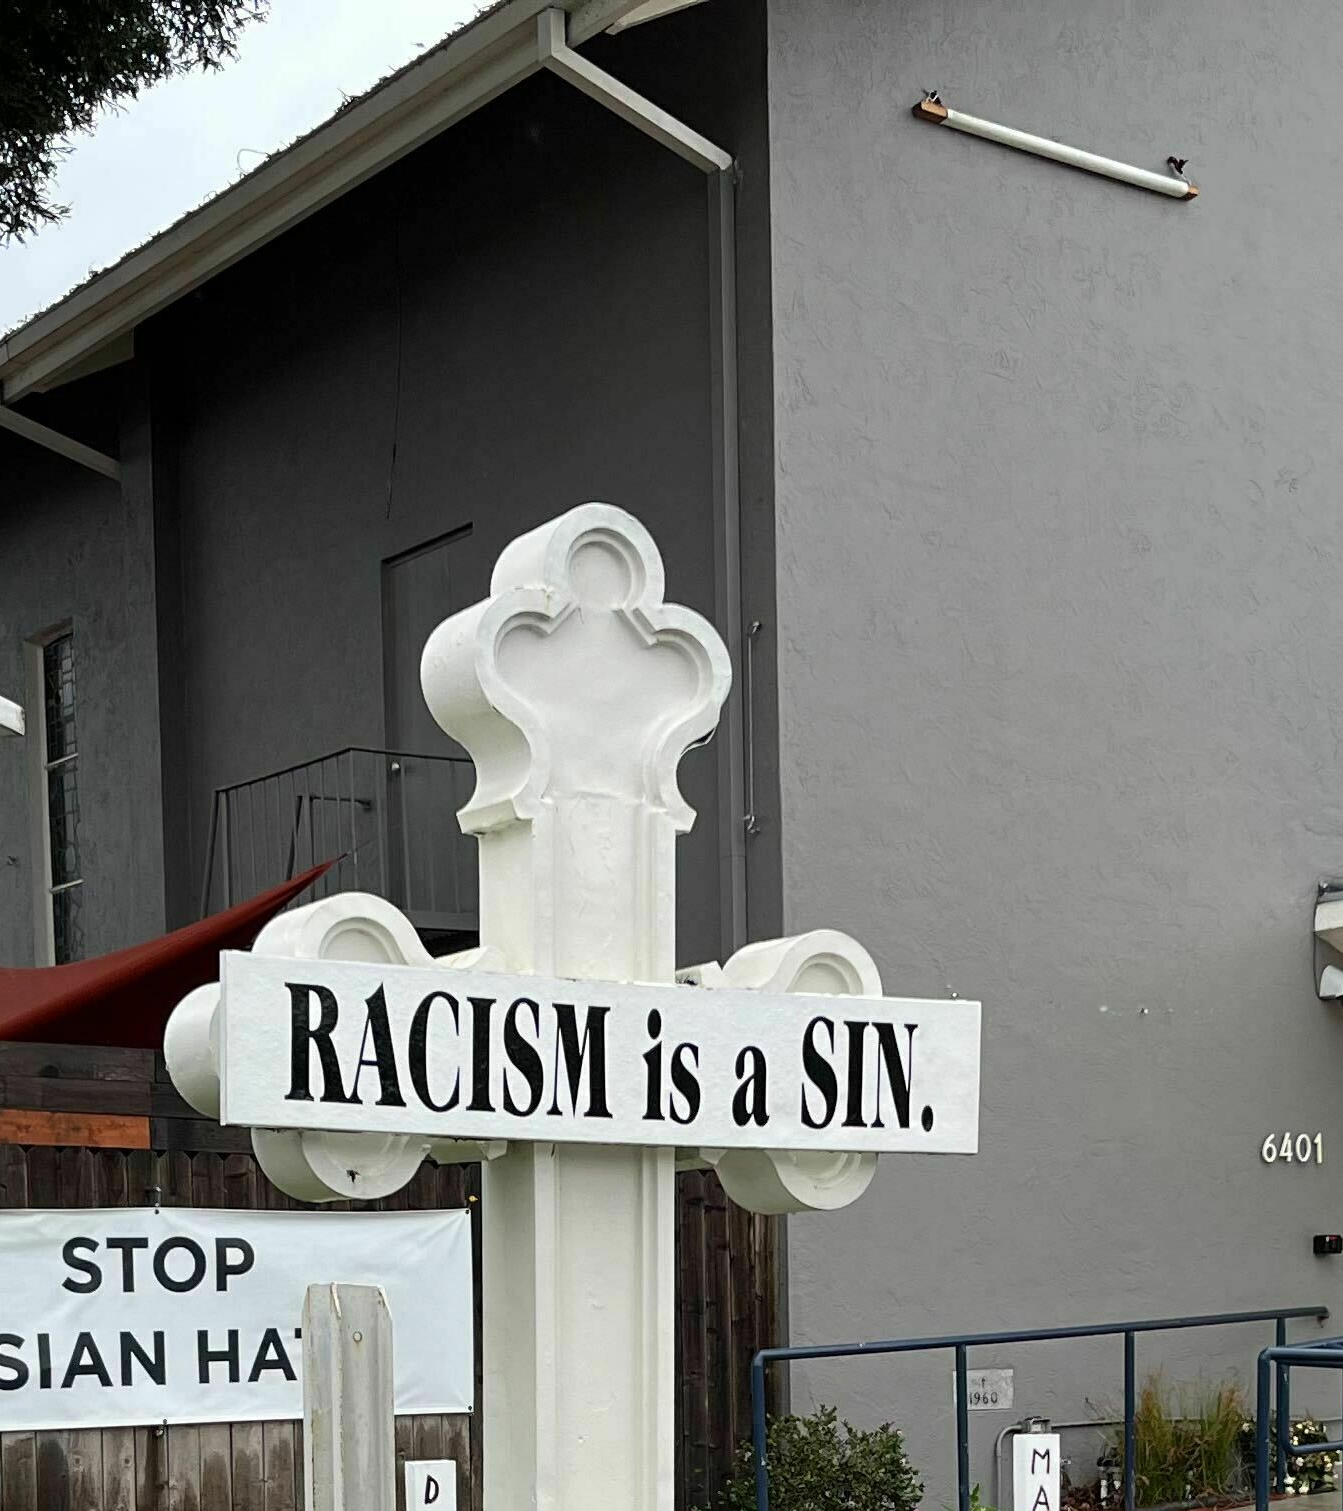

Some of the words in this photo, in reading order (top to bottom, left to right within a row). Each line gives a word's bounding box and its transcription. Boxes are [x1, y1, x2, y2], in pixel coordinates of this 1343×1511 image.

[285, 983, 612, 1118] RACISM
[643, 1009, 700, 1124] is
[733, 1046, 769, 1126] a
[802, 1017, 933, 1131] SIN.
[1261, 1132, 1323, 1164] 6401
[61, 1236, 255, 1294] STOP
[198, 1327, 302, 1384] HA
[969, 1391, 998, 1405] 1960
